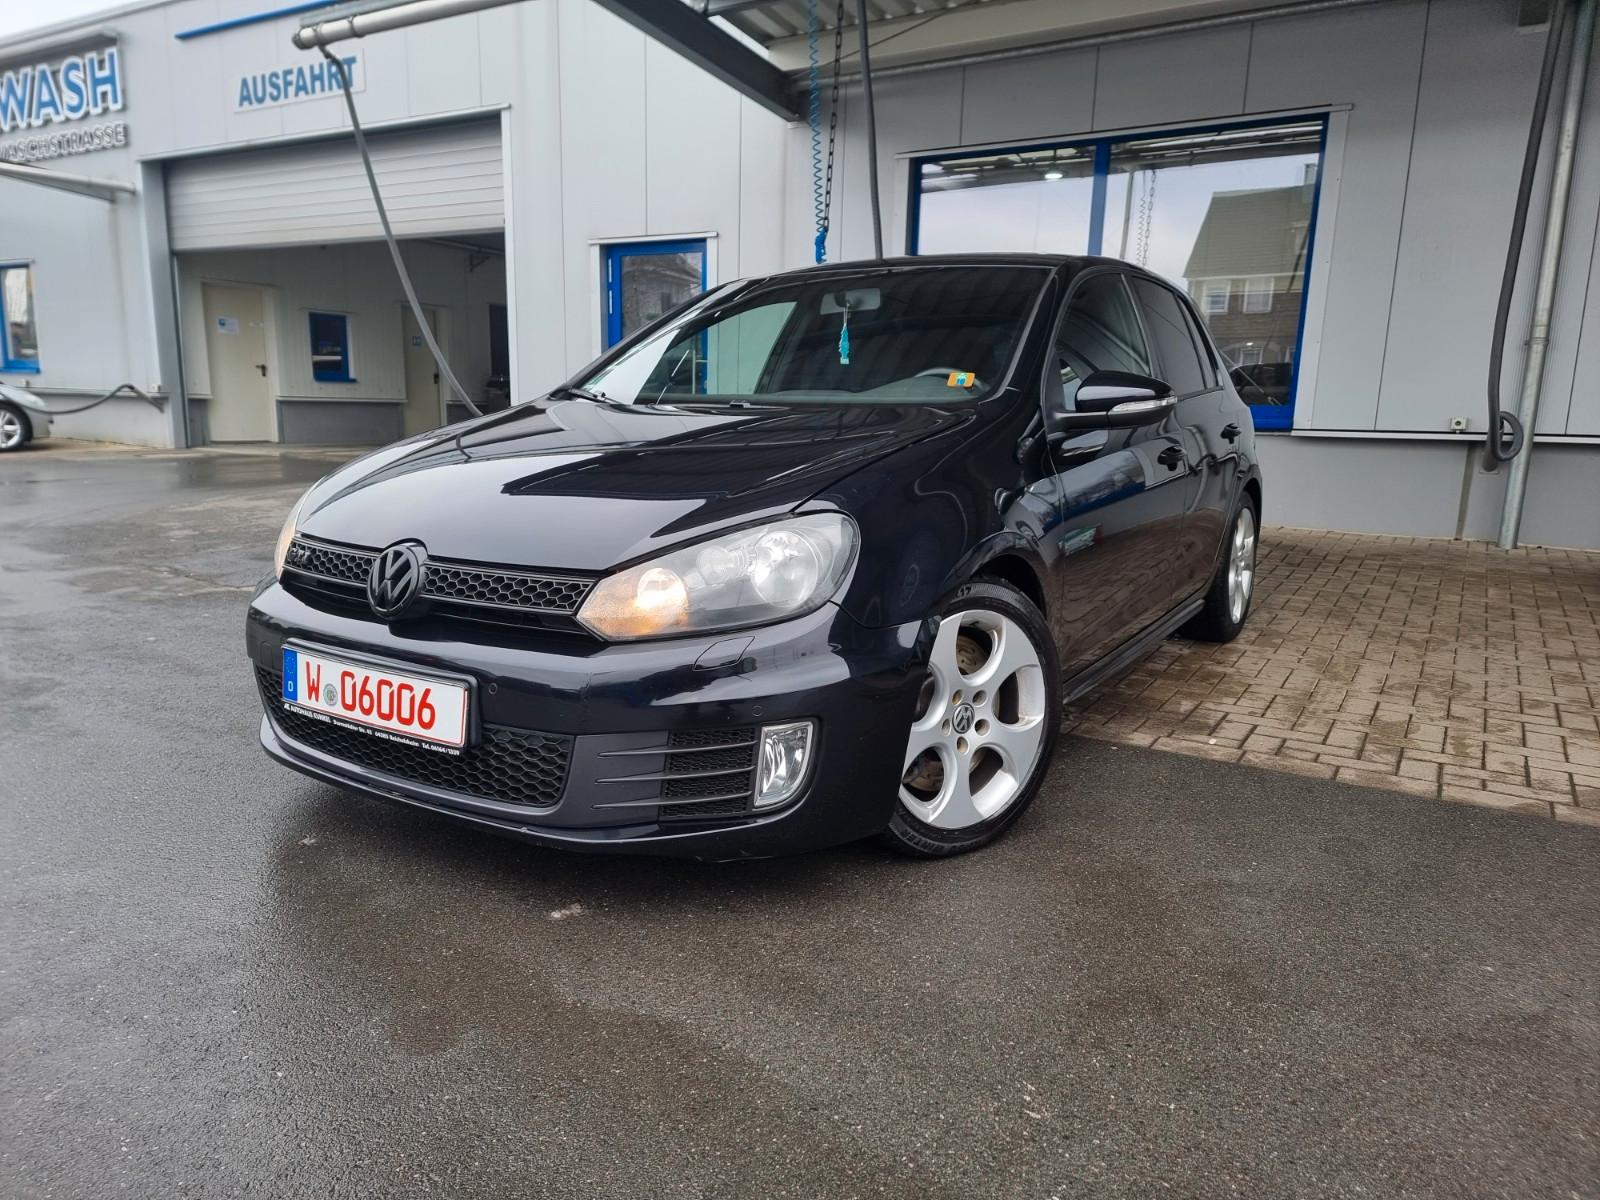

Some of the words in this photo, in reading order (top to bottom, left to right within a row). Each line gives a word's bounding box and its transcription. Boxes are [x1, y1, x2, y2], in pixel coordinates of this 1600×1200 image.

[0, 47, 122, 132] WASH
[238, 55, 357, 108] AUSFAHRT
[305, 661, 321, 702] W
[340, 670, 436, 730] 06006
